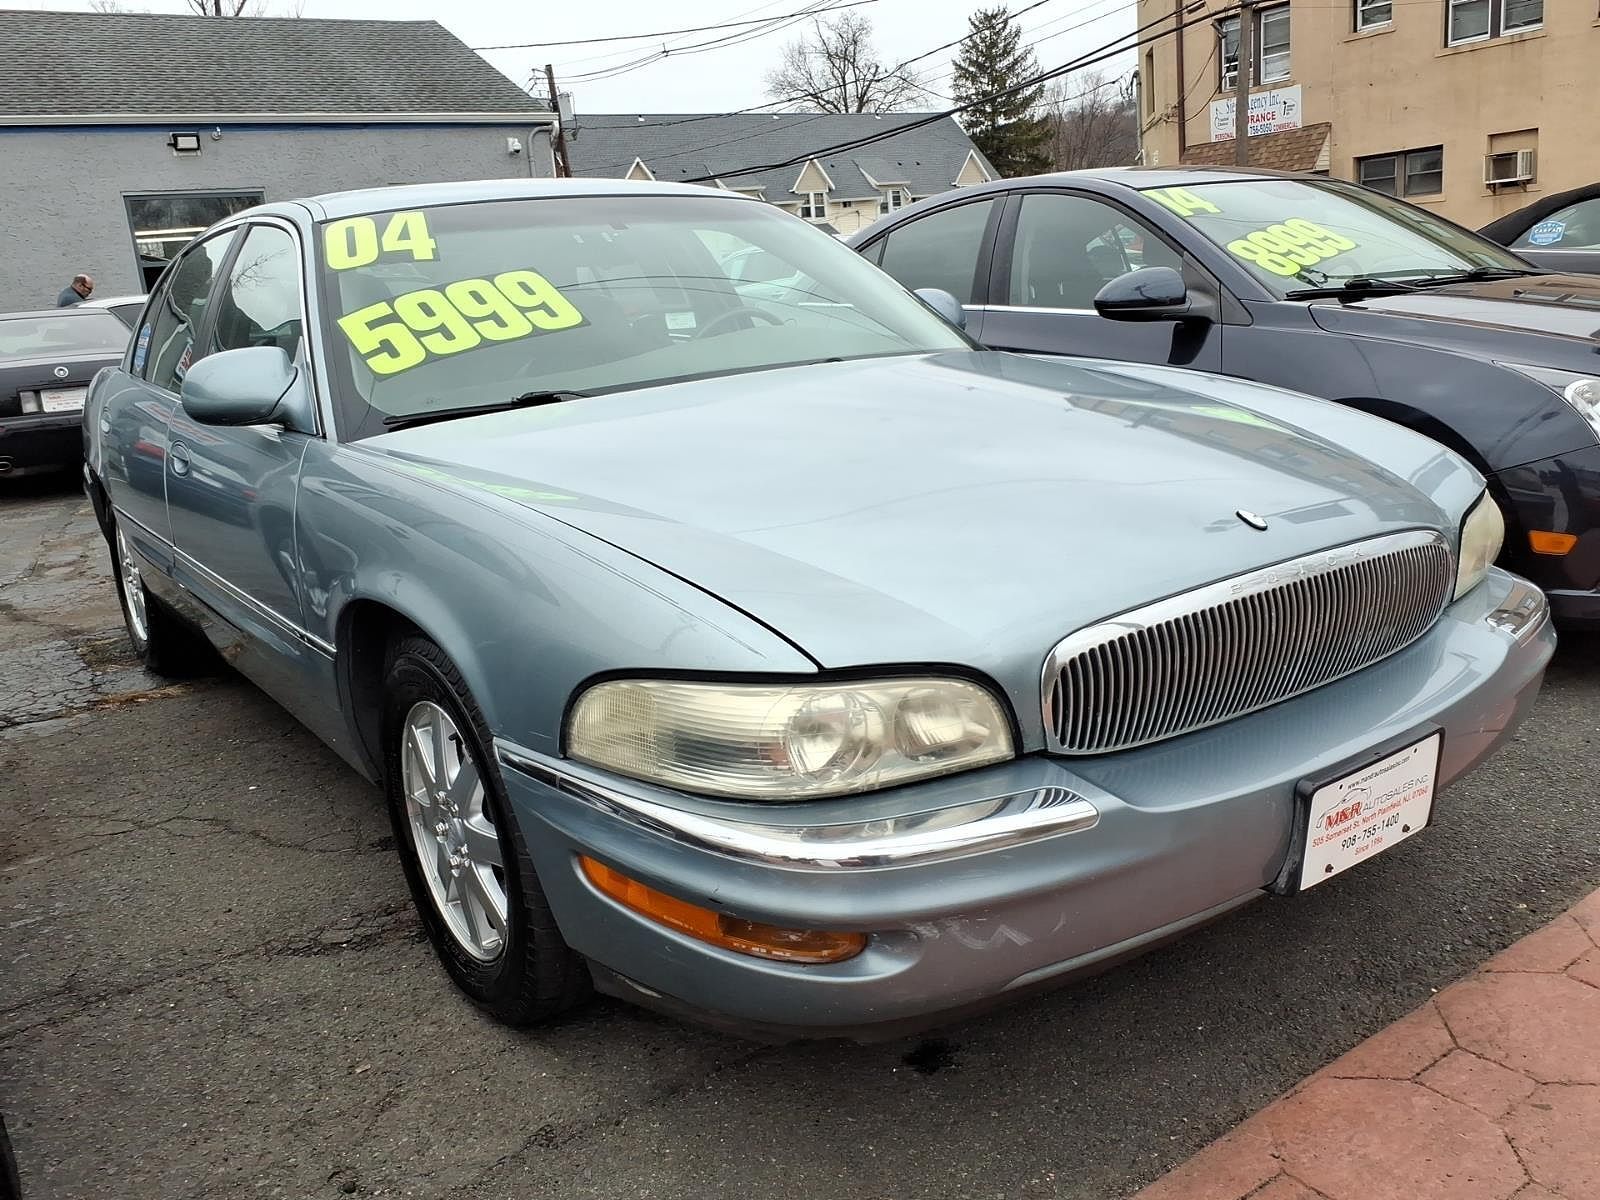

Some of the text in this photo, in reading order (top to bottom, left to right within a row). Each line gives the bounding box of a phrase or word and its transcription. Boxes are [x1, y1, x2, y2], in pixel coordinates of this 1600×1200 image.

[1140, 187, 1221, 217] 14
[325, 211, 437, 270] 04
[1226, 218, 1356, 276] 8999
[337, 270, 583, 374] 5999
[1325, 801, 1362, 830] M&R
[1363, 779, 1414, 811] AUTOSALES
[1326, 823, 1352, 843] Somerset
[1362, 813, 1377, 824] North
[1341, 812, 1399, 850] 908-755-1400
[1354, 843, 1370, 855] Since
